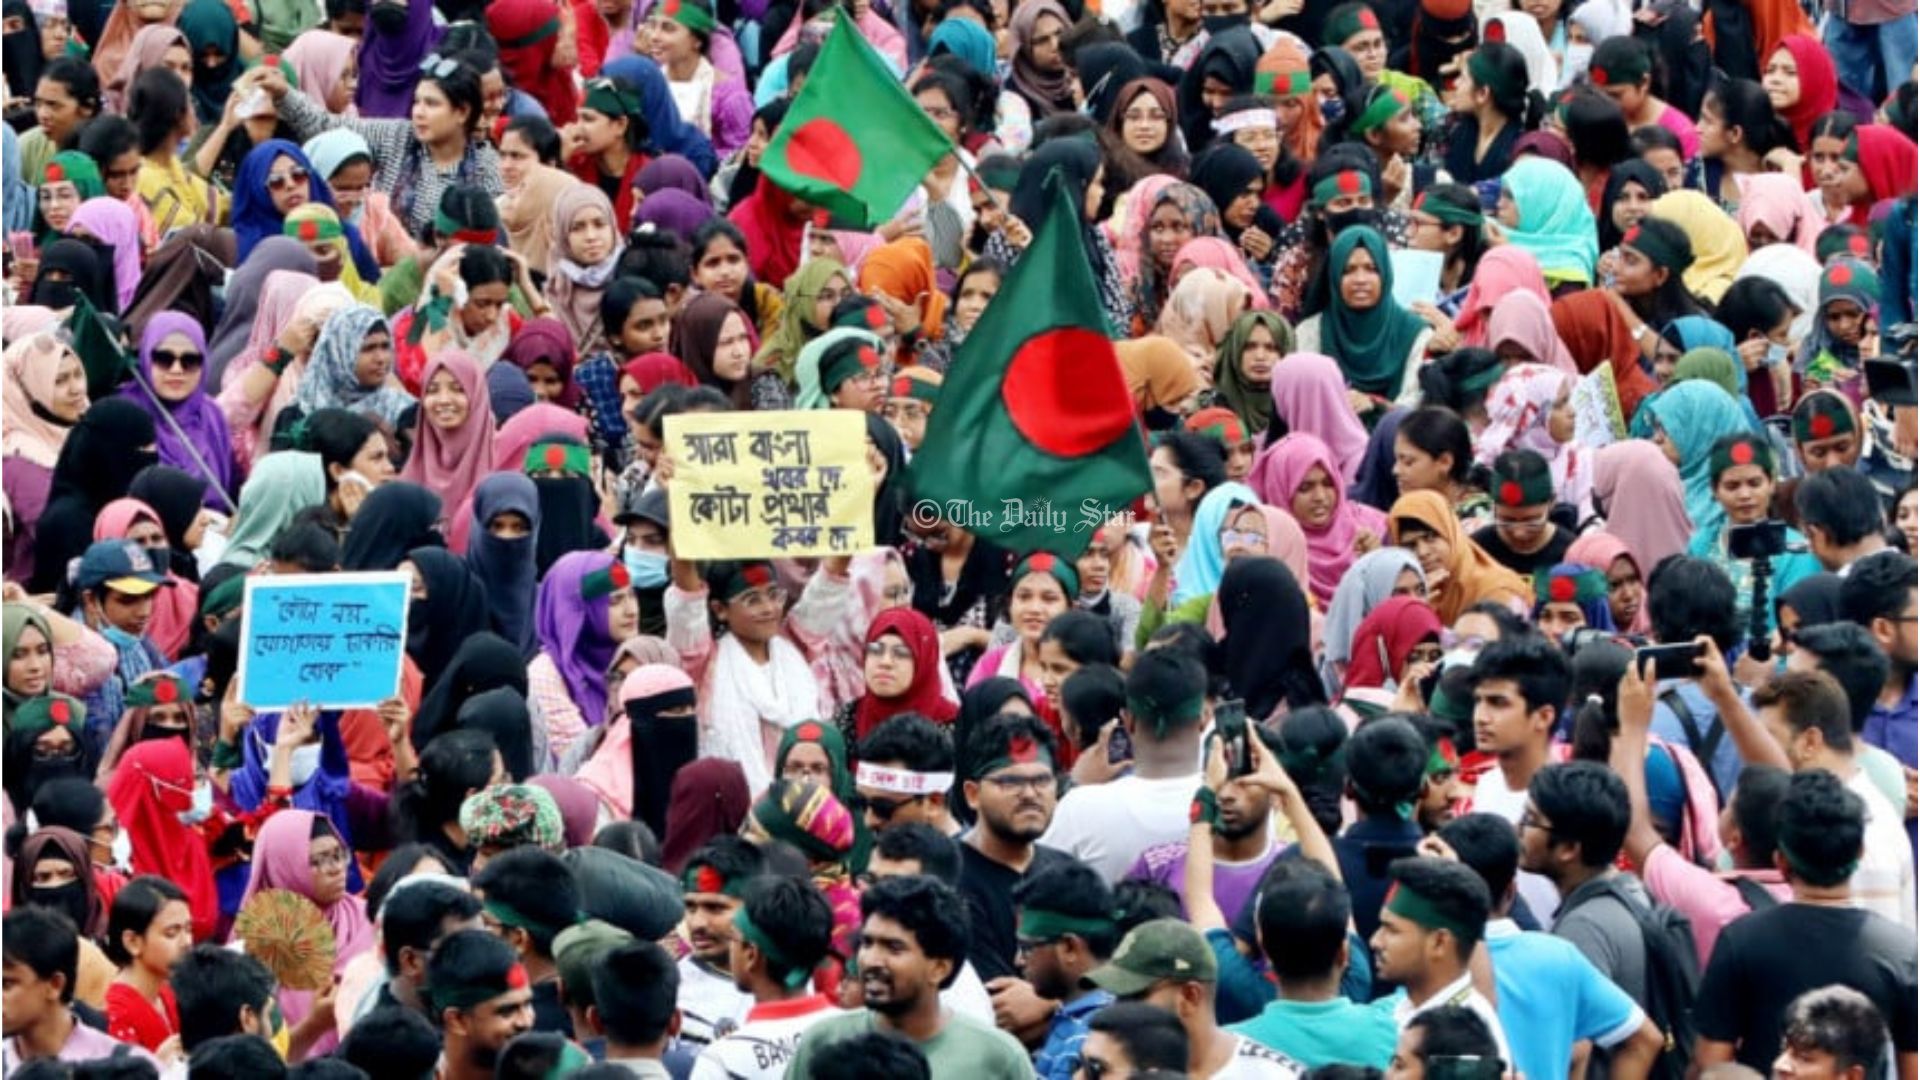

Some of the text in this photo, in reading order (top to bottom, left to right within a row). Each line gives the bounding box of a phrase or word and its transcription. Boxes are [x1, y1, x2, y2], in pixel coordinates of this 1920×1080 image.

[682, 430, 811, 465] সারা বাংলা
[762, 465, 808, 491] খবর
[689, 485, 829, 526] কোটা প্রথার
[771, 526, 822, 549] কবর
